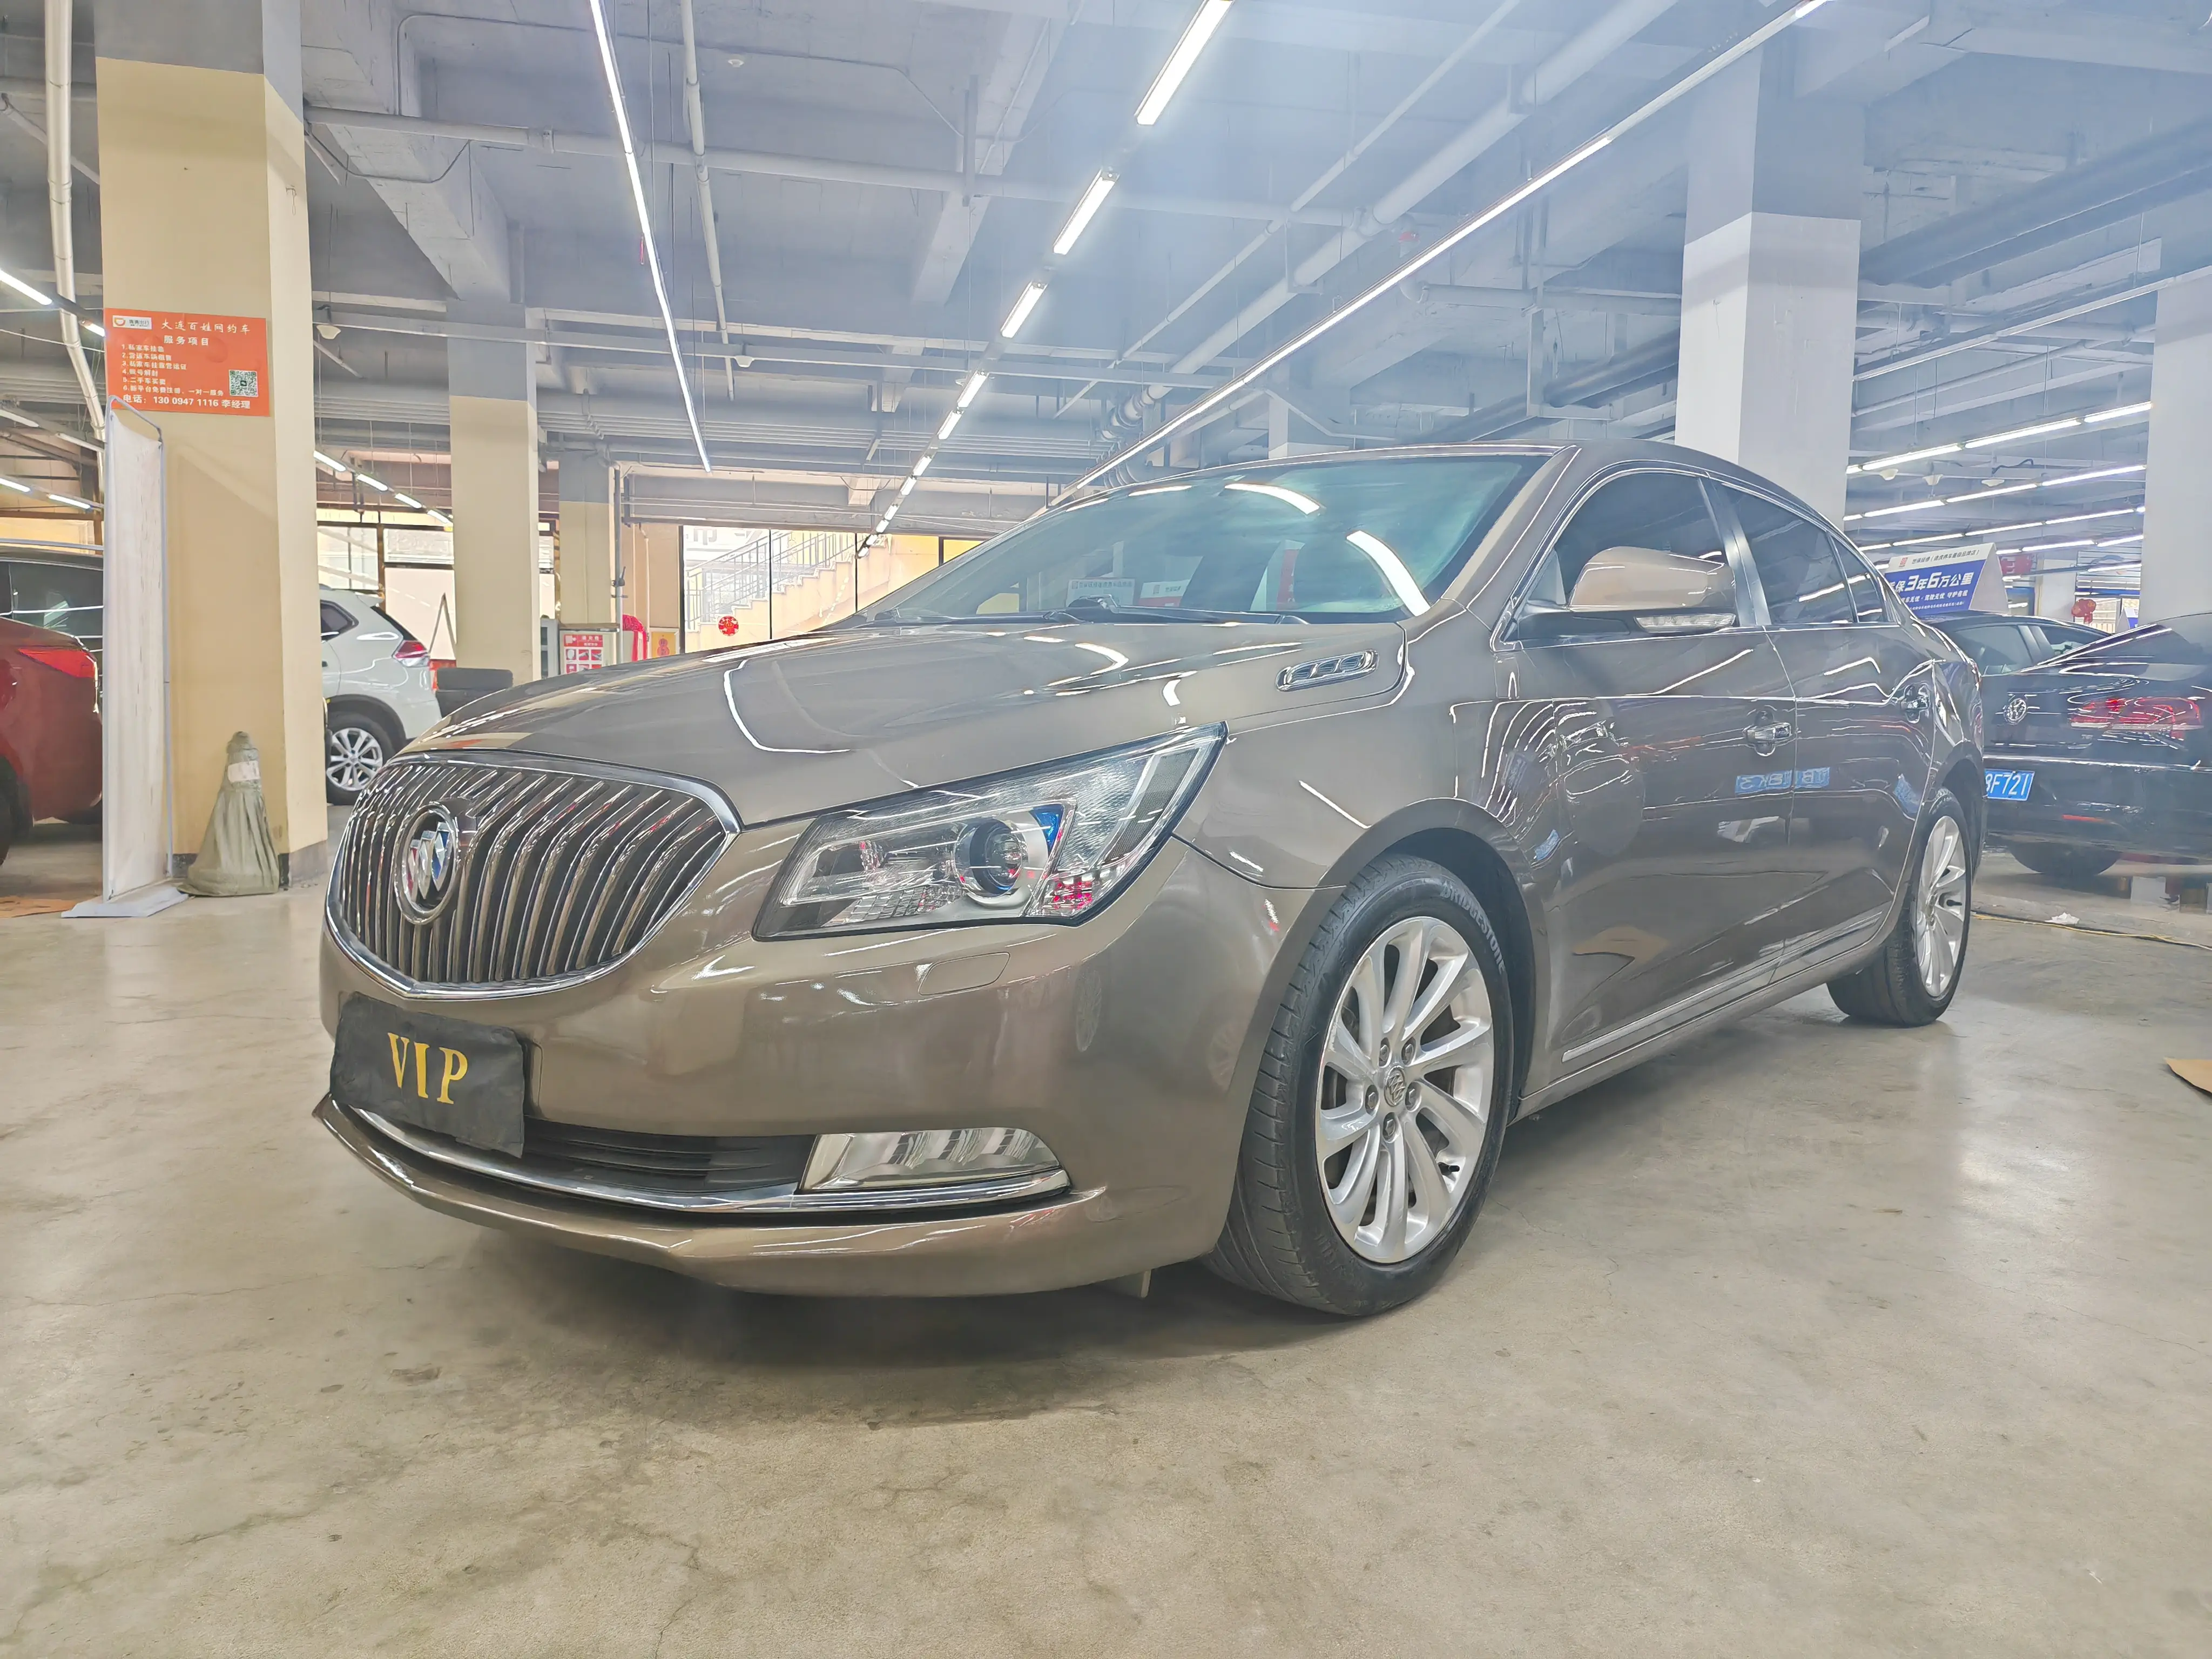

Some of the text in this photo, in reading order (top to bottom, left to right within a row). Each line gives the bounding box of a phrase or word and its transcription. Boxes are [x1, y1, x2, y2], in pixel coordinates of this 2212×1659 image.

[161, 318, 250, 335] 大连百姓网约车
[164, 335, 209, 346] 服务项目
[153, 396, 170, 404] 130
[172, 397, 194, 405] 0947
[197, 399, 219, 407] 1116
[221, 399, 250, 409] 李经理
[387, 1032, 468, 1105] VIP
